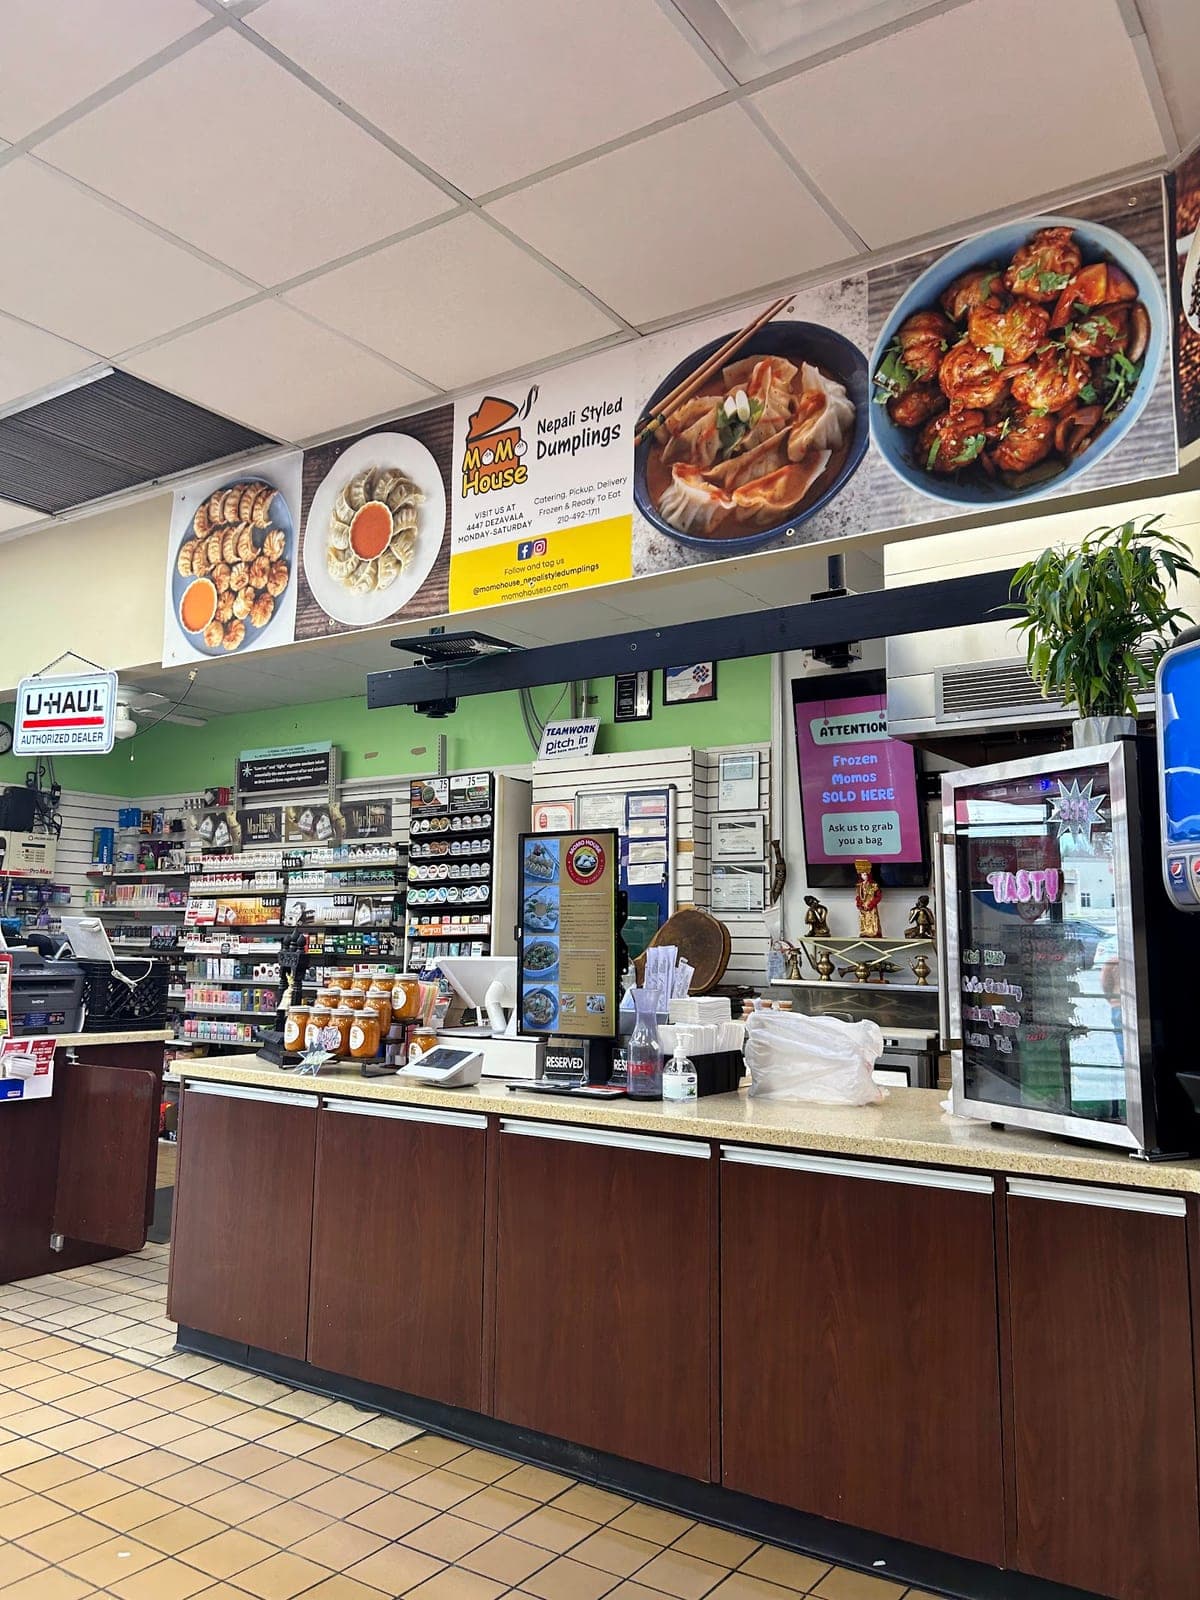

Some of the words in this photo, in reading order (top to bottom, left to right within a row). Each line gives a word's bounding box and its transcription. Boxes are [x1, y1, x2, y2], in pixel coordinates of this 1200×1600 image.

[537, 410, 576, 435] Nepali
[580, 396, 623, 423] Styled
[536, 424, 621, 460] Dumplings
[462, 464, 529, 498] House
[597, 476, 628, 490] Delivery
[538, 505, 563, 516] Frozen
[564, 503, 570, 511] &
[571, 497, 595, 509] Ready
[597, 493, 606, 502] To
[607, 490, 621, 499] Eat
[474, 507, 494, 520] VISIT
[494, 505, 505, 515] US
[506, 504, 517, 513] AT
[557, 507, 601, 525] 210-492-1711
[466, 521, 484, 532] 4447
[485, 513, 524, 528] DEZAVALA
[458, 519, 533, 544] MONDAY-SATURDAY
[504, 564, 526, 575] Follow
[527, 562, 541, 571] and
[542, 559, 555, 569] tag
[26, 689, 104, 715] U-HAUL
[546, 724, 596, 736] TEAMWORK
[820, 721, 887, 737] ATTENTION
[21, 733, 70, 745] AUTHORIZED
[72, 732, 104, 743] DEALER
[546, 737, 574, 754] pitch
[578, 735, 588, 744] in
[832, 754, 878, 767] Frozen
[831, 772, 877, 785] Momos
[822, 790, 856, 804] SOLD
[861, 788, 895, 801] HERE
[829, 822, 845, 833] Ask
[860, 823, 869, 832] to
[871, 821, 893, 834] grab
[838, 836, 855, 848] you
[865, 835, 883, 847] bag
[546, 1056, 583, 1069] RESERVED
